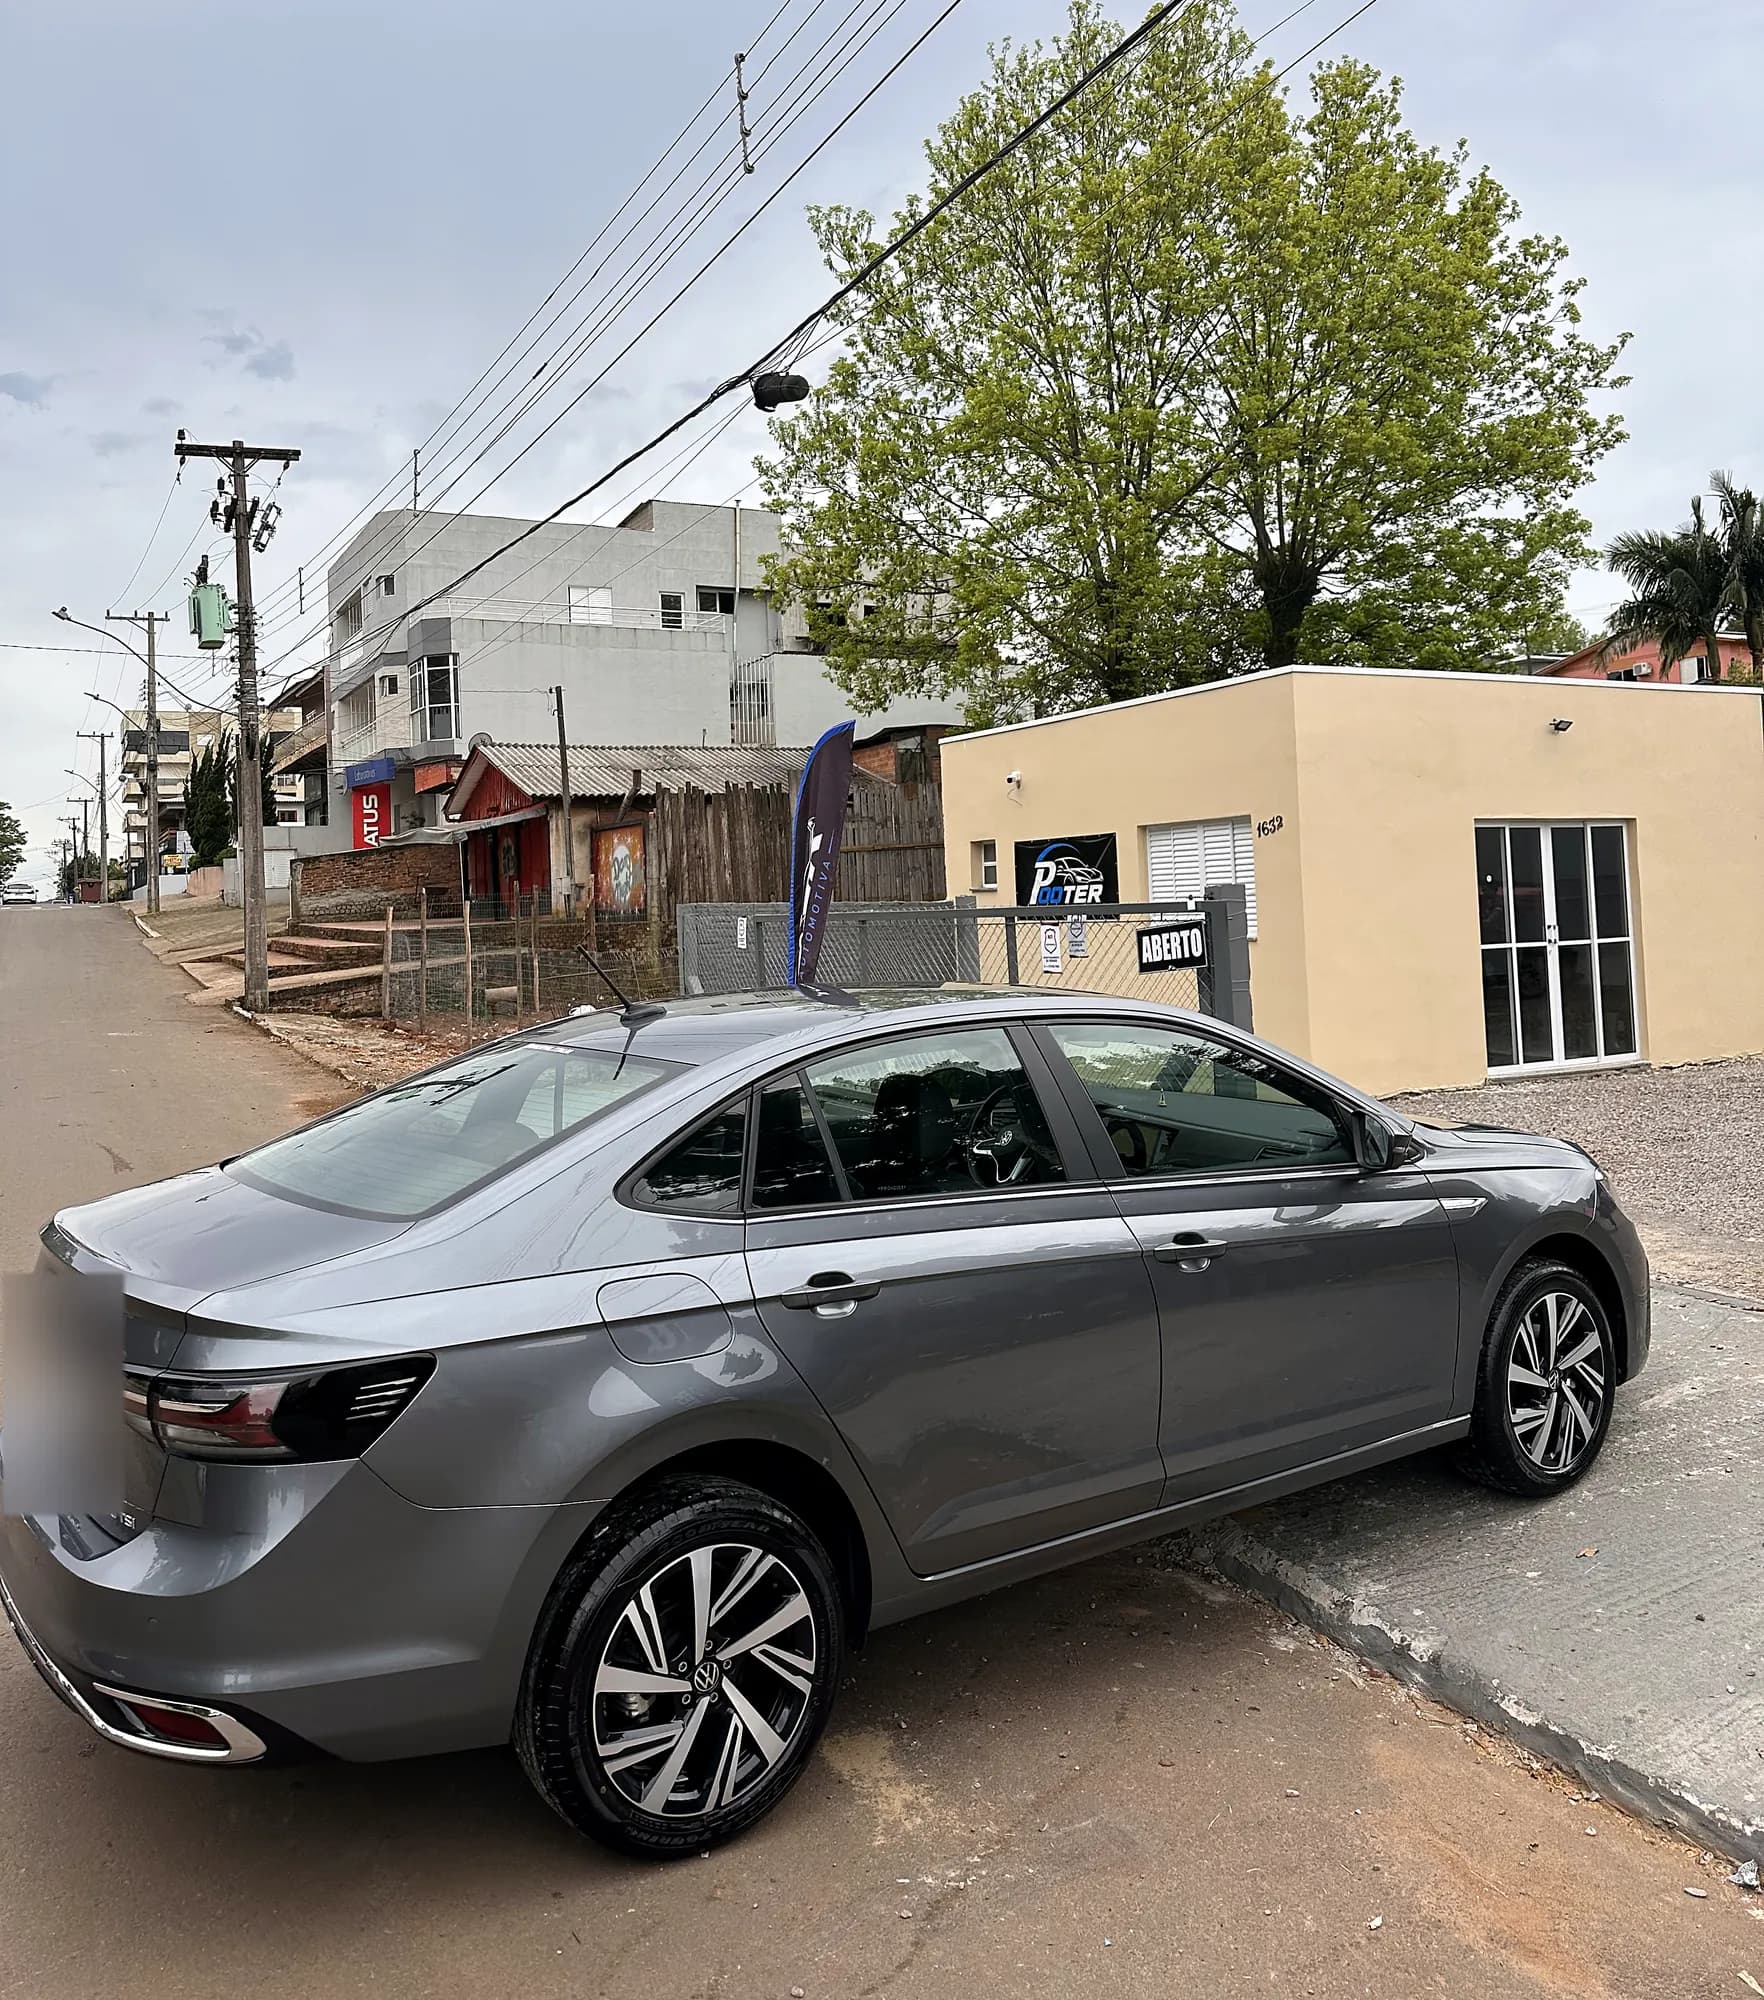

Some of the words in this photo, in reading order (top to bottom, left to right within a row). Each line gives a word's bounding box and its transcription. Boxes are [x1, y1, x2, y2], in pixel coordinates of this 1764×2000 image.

[363, 794, 379, 847] ATUS
[1257, 815, 1284, 838] 1632
[1142, 928, 1203, 964] ABERTO
